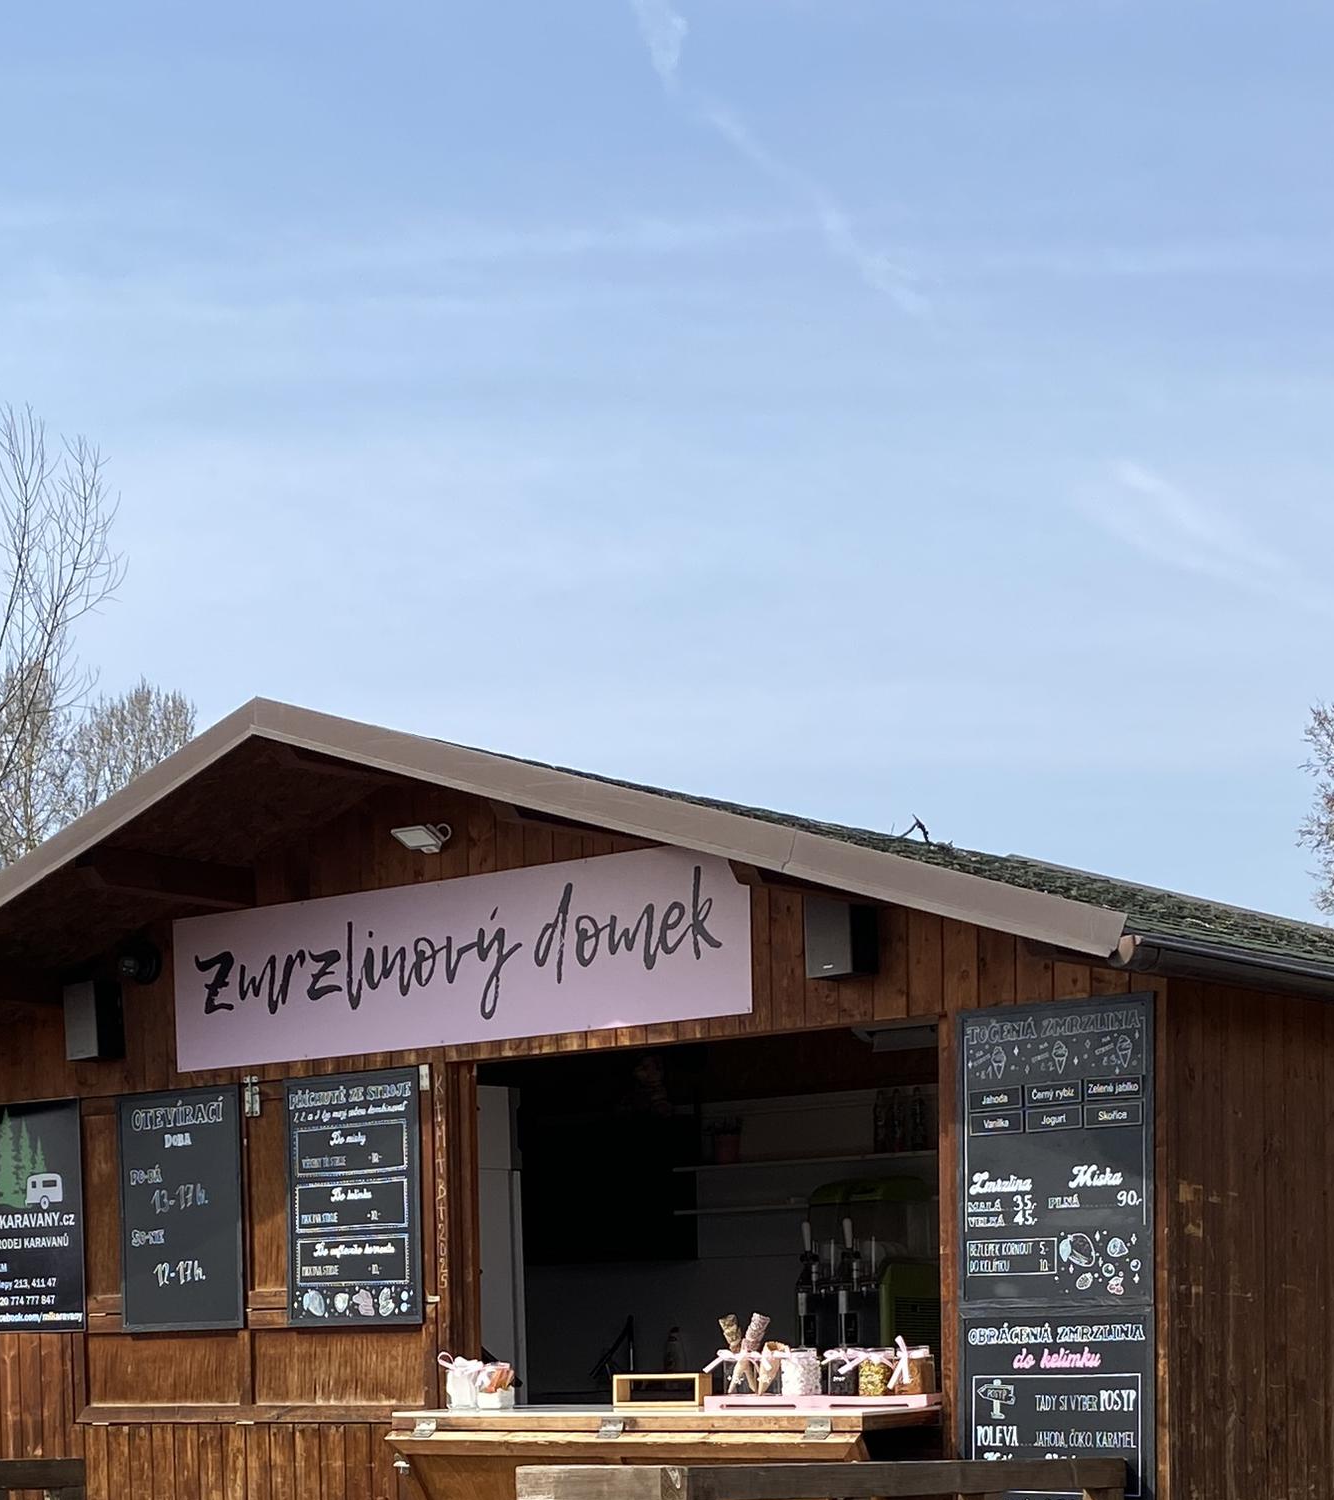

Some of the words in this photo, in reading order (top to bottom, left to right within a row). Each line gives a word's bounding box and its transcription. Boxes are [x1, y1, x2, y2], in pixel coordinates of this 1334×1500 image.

[195, 907, 522, 1020] Zmrzlinový
[534, 865, 723, 984] domek
[966, 1016, 1037, 1045] TOČENÁ
[1041, 1009, 1142, 1038] ZMRZLINA
[348, 1086, 365, 1103] ZE
[366, 1081, 412, 1101] STROJE
[981, 1093, 1009, 1105] Jahoda
[1031, 1088, 1054, 1100] Černý
[131, 1096, 224, 1132] OTEVÍRACÍ
[1040, 1113, 1067, 1126] Jogurt
[982, 1118, 1010, 1129] Vanilka
[164, 1132, 192, 1149] DOBA
[129, 1164, 163, 1186] PO-PÁ
[969, 1171, 1033, 1195] Zmrzlina
[1068, 1164, 1123, 1188] Miska
[967, 1199, 1002, 1213] MALÁ
[1048, 1194, 1080, 1209] PLNÁ
[968, 1213, 1005, 1228] VELKÁ
[23, 1232, 69, 1249] KARAVANŮ
[131, 1229, 165, 1247] SO-NE
[969, 1243, 999, 1257] BEZLEPEK
[1000, 1242, 1033, 1255] KORNOUT
[13, 1279, 31, 1289] 213,
[31, 1278, 46, 1289] 411
[46, 1277, 57, 1287] 47
[10, 1296, 25, 1306] 774
[25, 1295, 40, 1305] 777
[967, 1322, 1053, 1345] OBRÁCENÁ
[1056, 1323, 1146, 1342] ZMRZLINA
[1012, 1348, 1036, 1369] do
[1039, 1346, 1102, 1369] kelímku
[986, 1388, 1007, 1400] POSYP
[1034, 1394, 1057, 1411] TADY
[1058, 1395, 1069, 1411] SI
[1069, 1394, 1099, 1411] VYBER
[1099, 1389, 1137, 1412] POSYP
[976, 1425, 1018, 1446] POLEVA
[1095, 1431, 1137, 1448] KARAMEL
